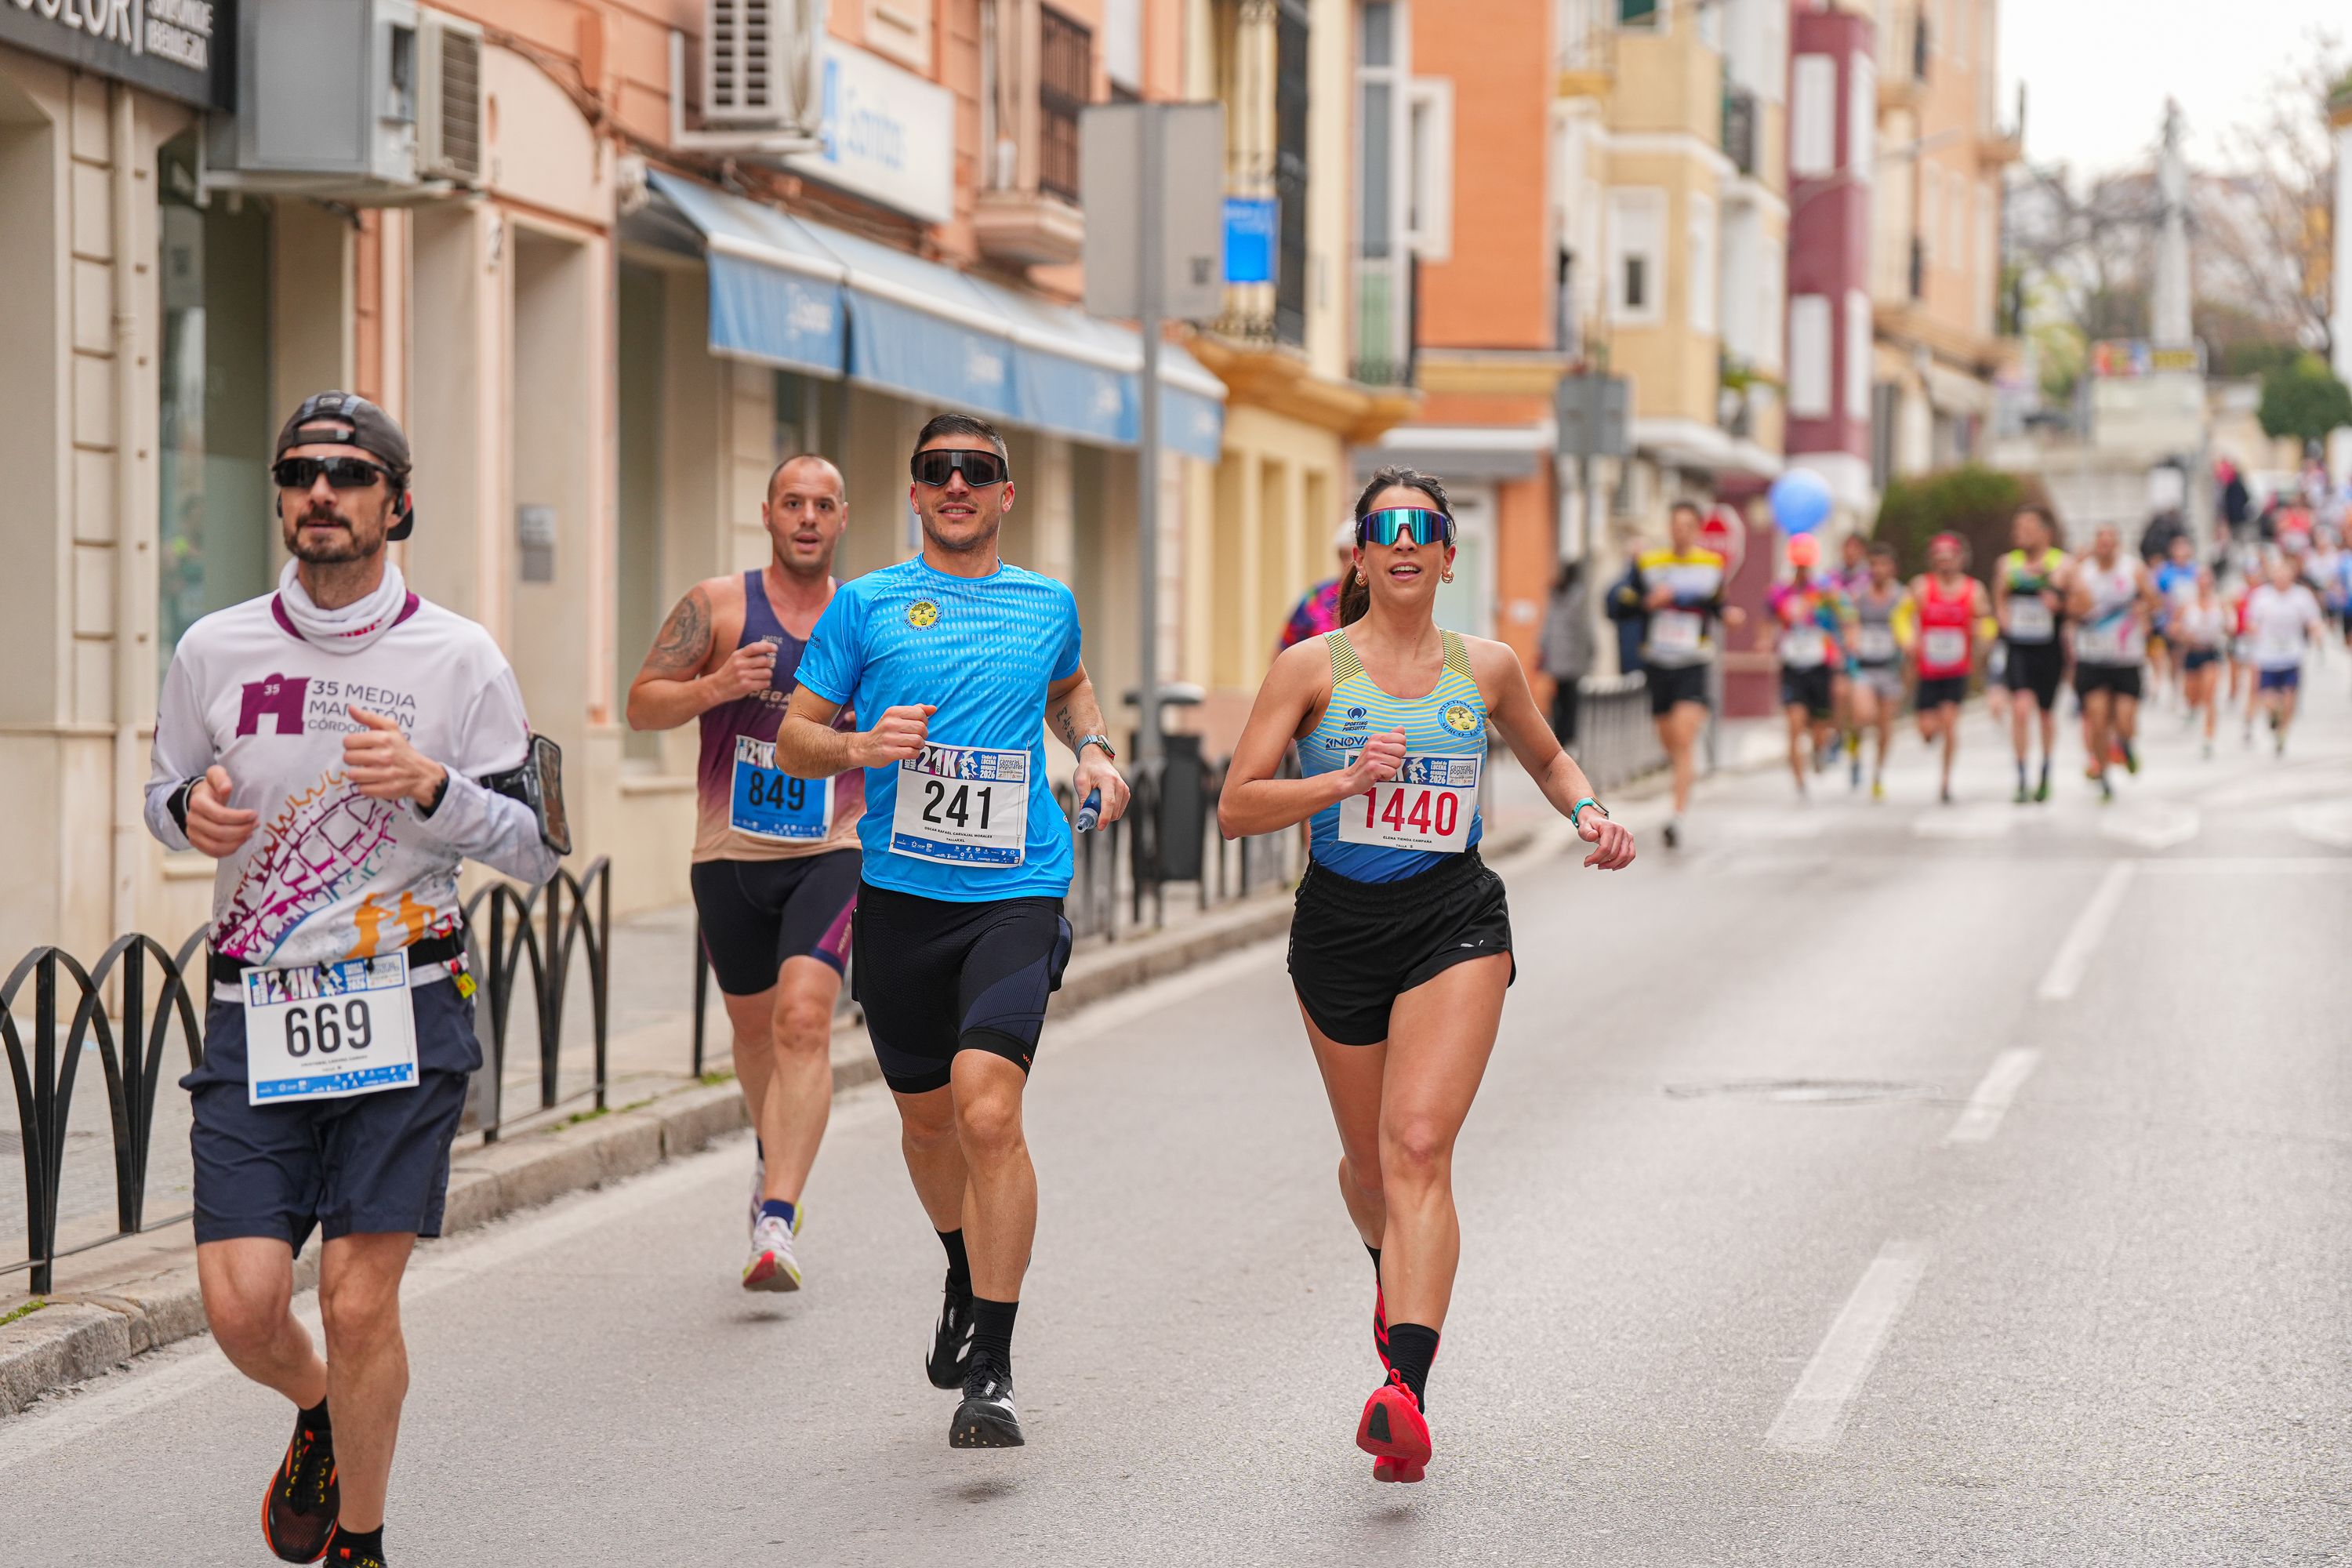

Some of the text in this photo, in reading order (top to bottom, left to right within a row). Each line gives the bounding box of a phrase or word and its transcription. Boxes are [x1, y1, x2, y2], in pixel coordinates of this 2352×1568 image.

[311, 680, 416, 710] 35 MEDIA
[917, 746, 959, 778] 21K
[979, 770, 996, 779] 2026
[1429, 775, 1446, 784] 2026
[749, 770, 805, 811] 849
[922, 779, 992, 829] 241
[1361, 786, 1458, 837] 1440
[285, 999, 372, 1058] 669
